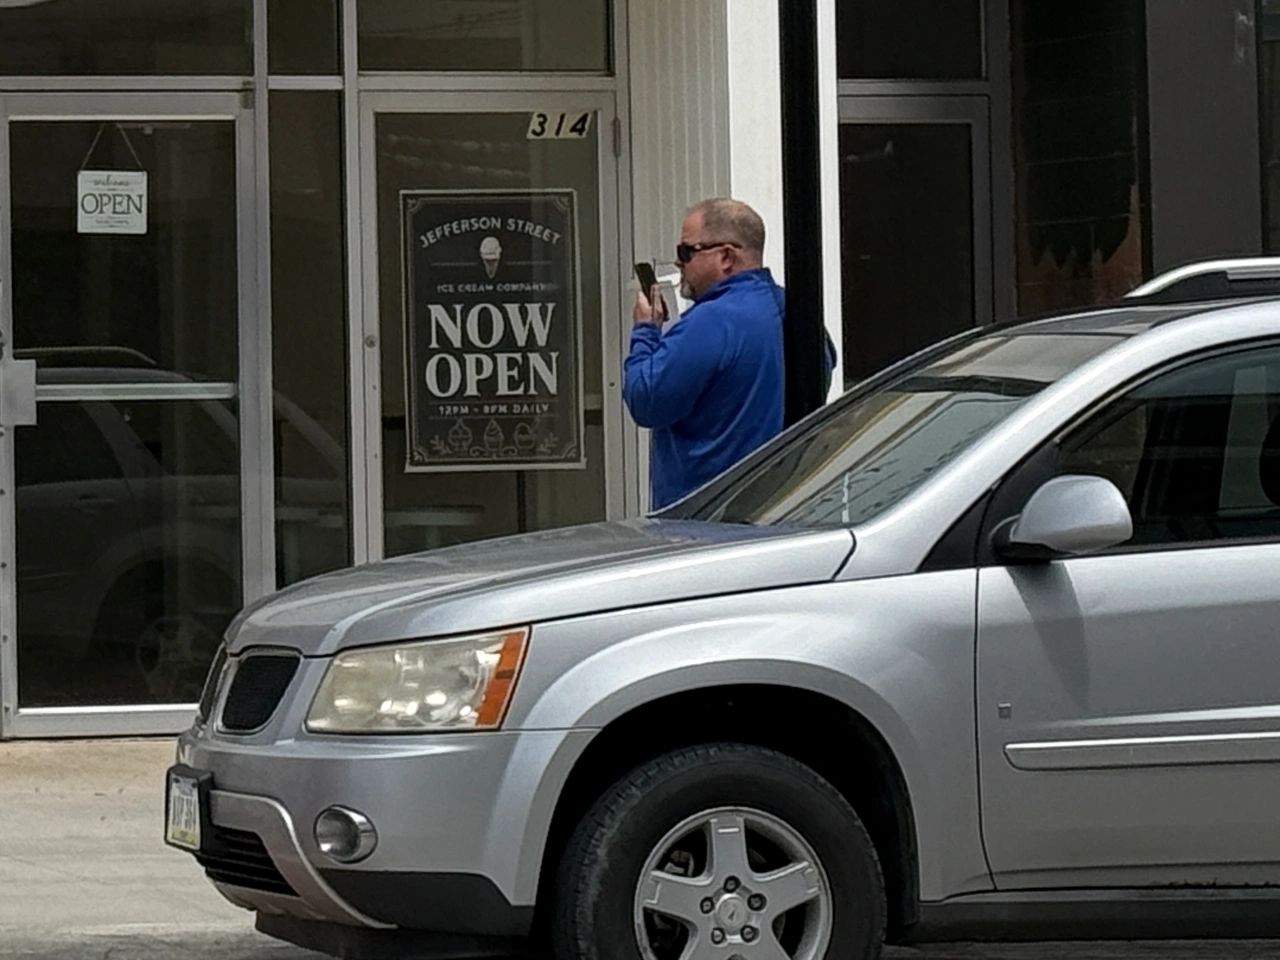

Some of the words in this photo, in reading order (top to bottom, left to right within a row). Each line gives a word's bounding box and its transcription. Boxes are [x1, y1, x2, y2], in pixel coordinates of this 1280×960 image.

[530, 112, 590, 137] 314
[80, 192, 144, 215] OPEN
[420, 217, 501, 248] JEFFERSON
[506, 218, 561, 245] STREET
[427, 302, 557, 349] NOW
[424, 351, 560, 398] OPEN
[512, 403, 549, 414] DAILY
